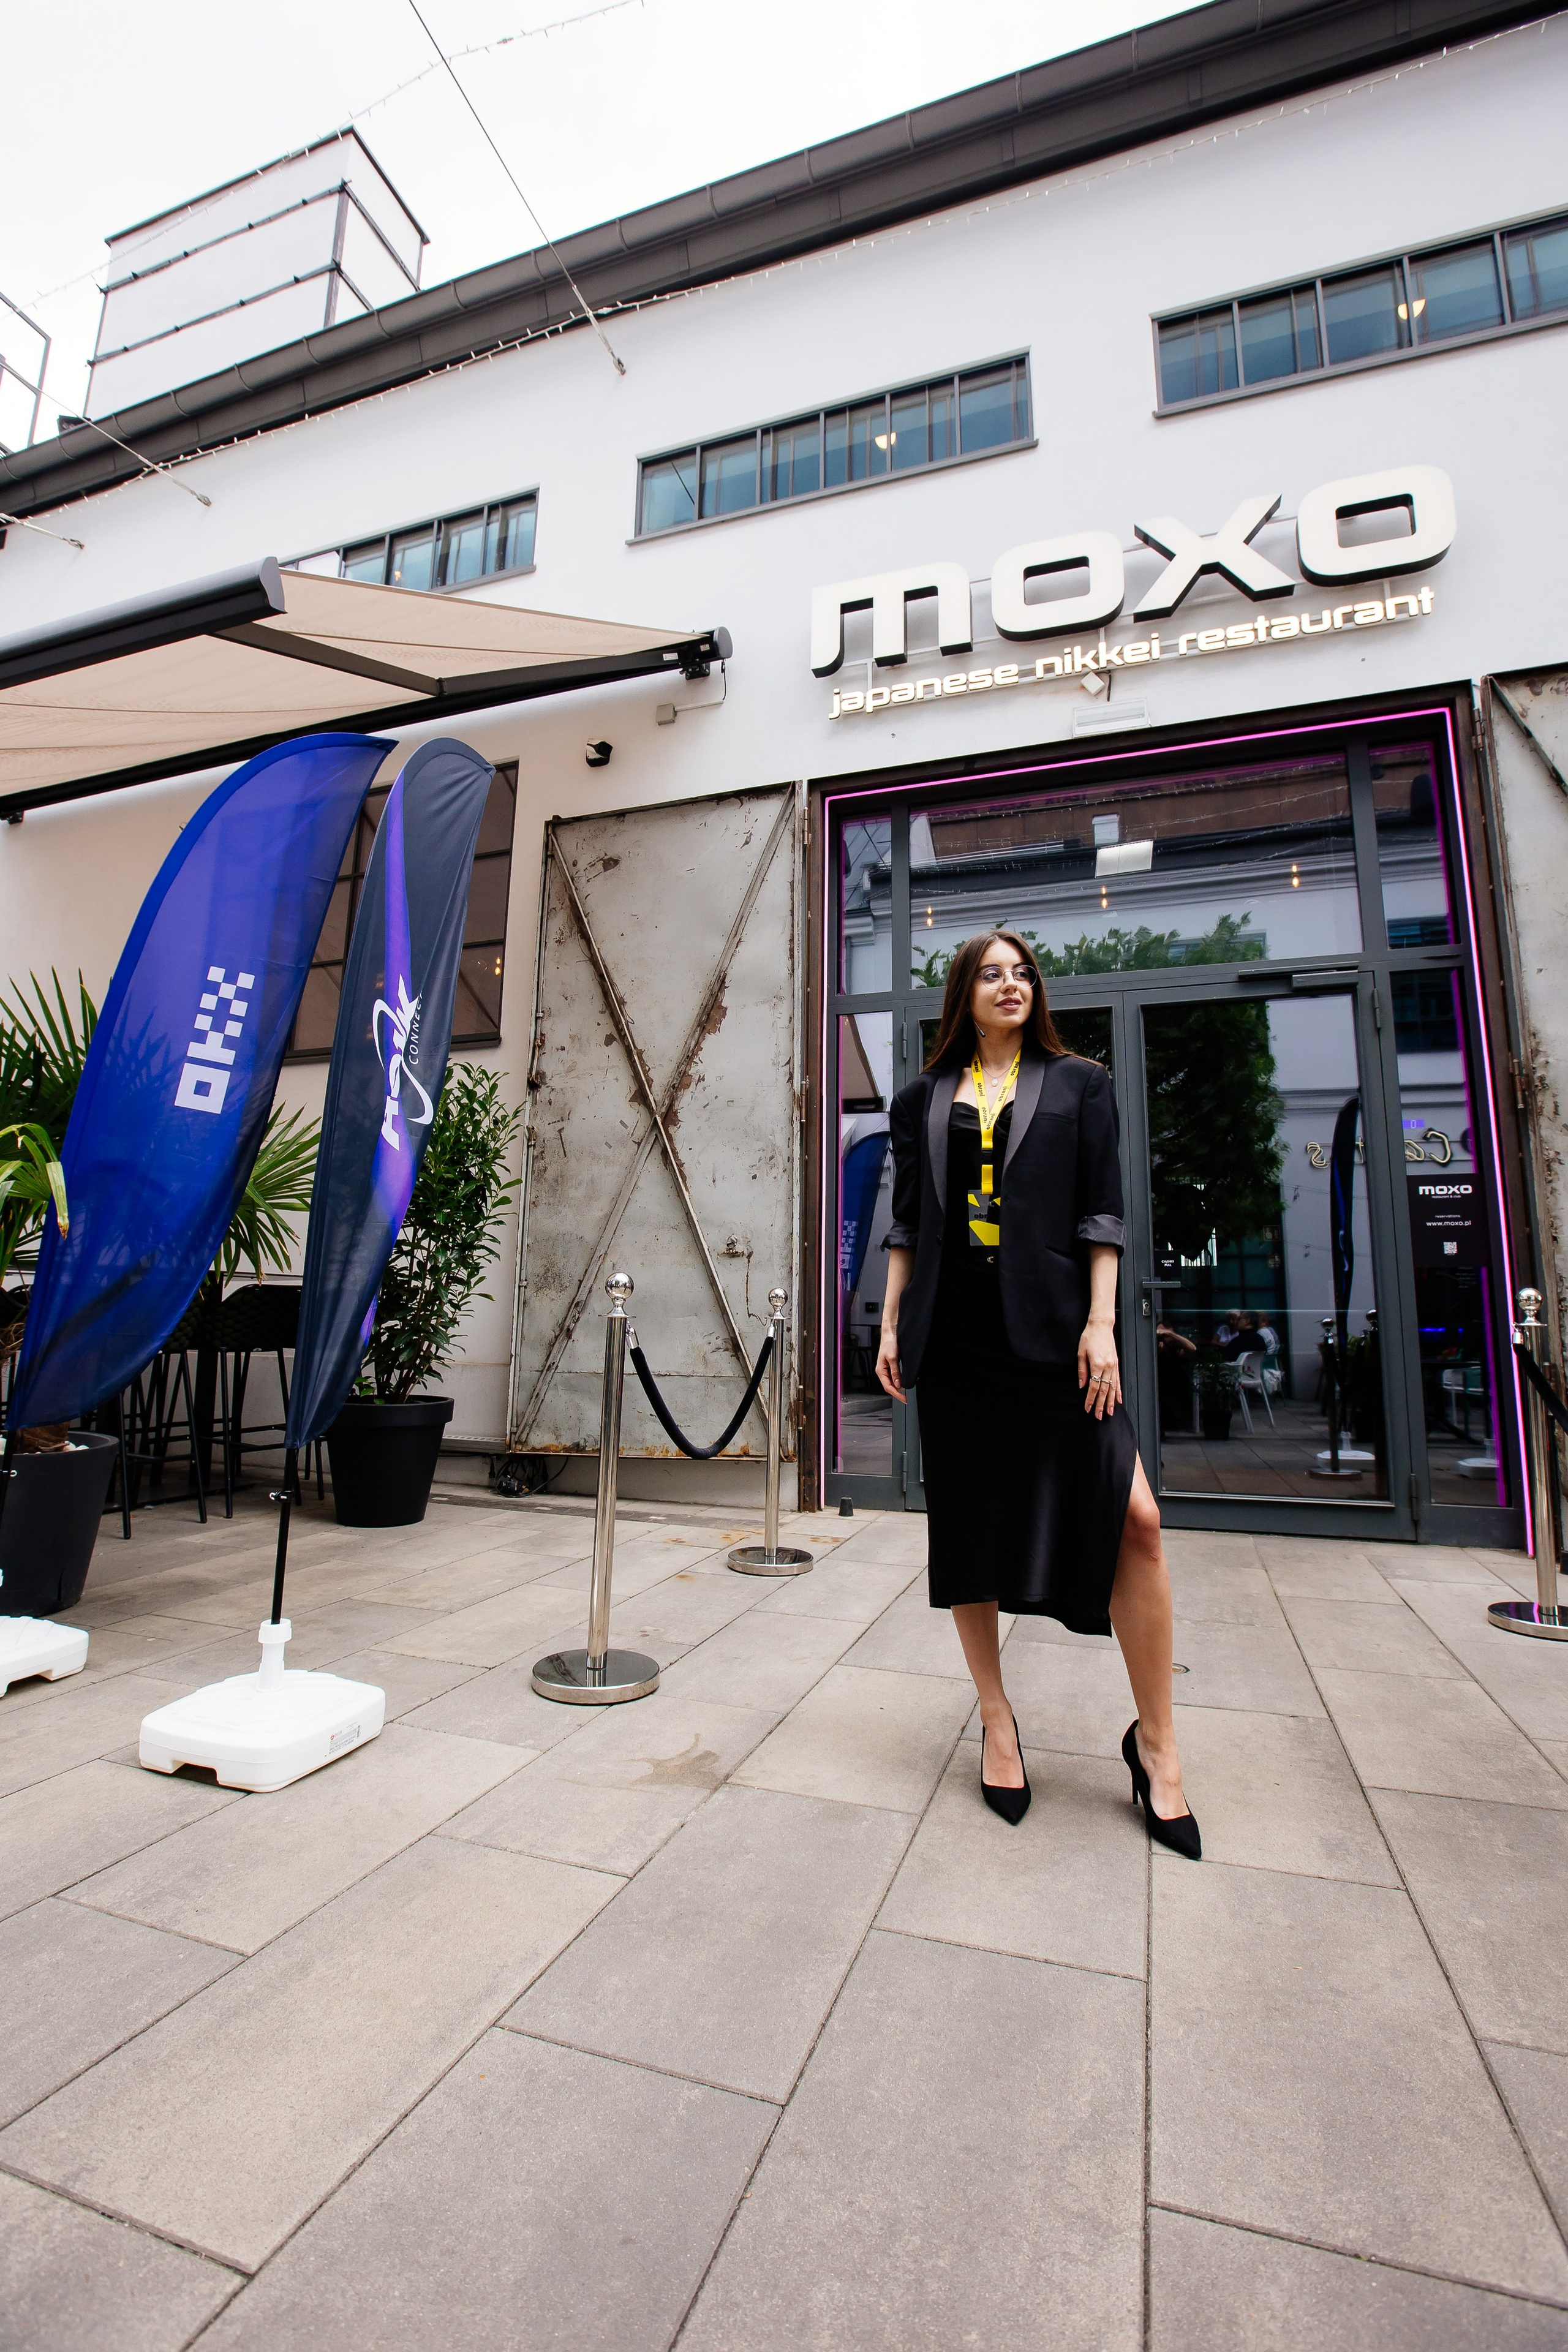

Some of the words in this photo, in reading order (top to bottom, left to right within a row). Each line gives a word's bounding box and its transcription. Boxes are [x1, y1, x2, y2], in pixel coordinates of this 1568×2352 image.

[828, 663, 1020, 720] japanese
[1035, 633, 1162, 680] nikkei
[1178, 586, 1435, 656] restaurant
[1011, 1061, 1019, 1076] obrani
[998, 1086, 1008, 1101] obrani
[987, 1113, 995, 1129] obrani
